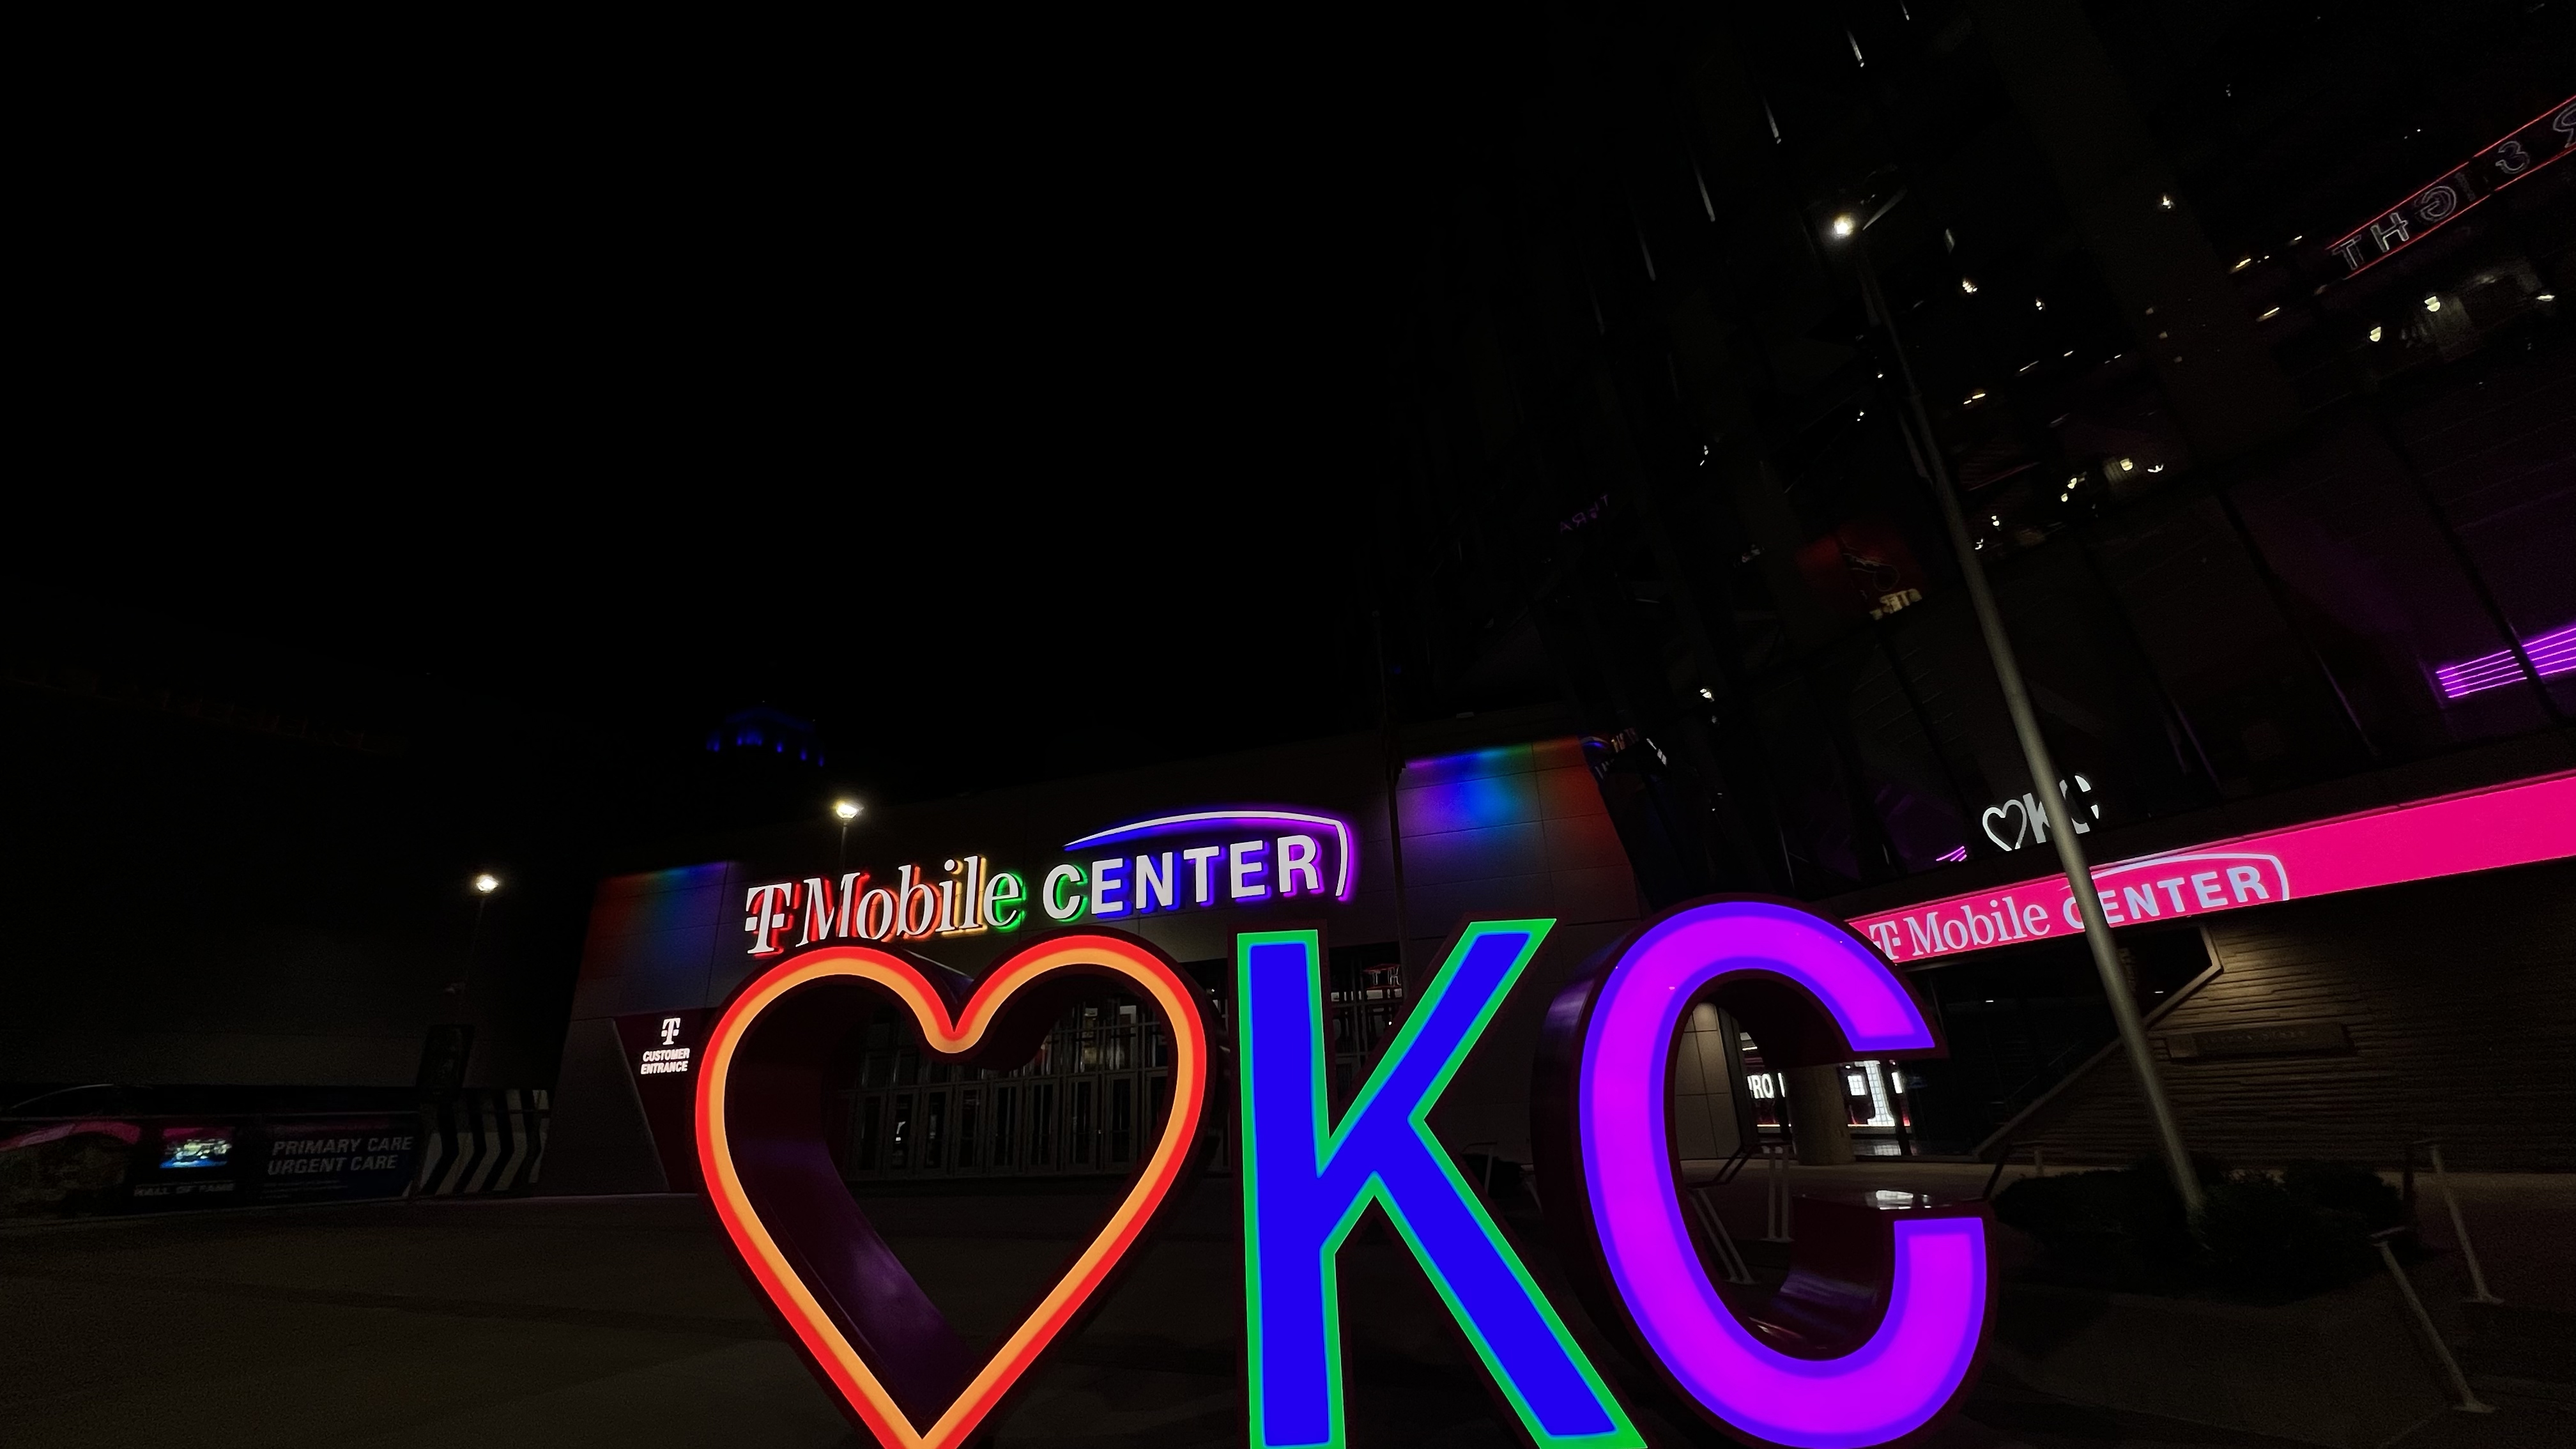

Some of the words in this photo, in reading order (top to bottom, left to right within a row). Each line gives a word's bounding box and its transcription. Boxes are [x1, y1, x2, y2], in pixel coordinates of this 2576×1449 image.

[795, 855, 1020, 947] Mobile
[1043, 834, 1321, 920] CENTER
[1903, 897, 2051, 956] Mobile
[2063, 864, 2272, 931] CENTER
[643, 1048, 690, 1061] CUSTOMER
[641, 1061, 688, 1075] ENTRANCE
[272, 1137, 362, 1156] PRIMARY
[367, 1135, 414, 1152] CARE
[268, 1156, 346, 1176] URGENT
[350, 1153, 398, 1171] CARE
[1237, 901, 1985, 1449] KC
